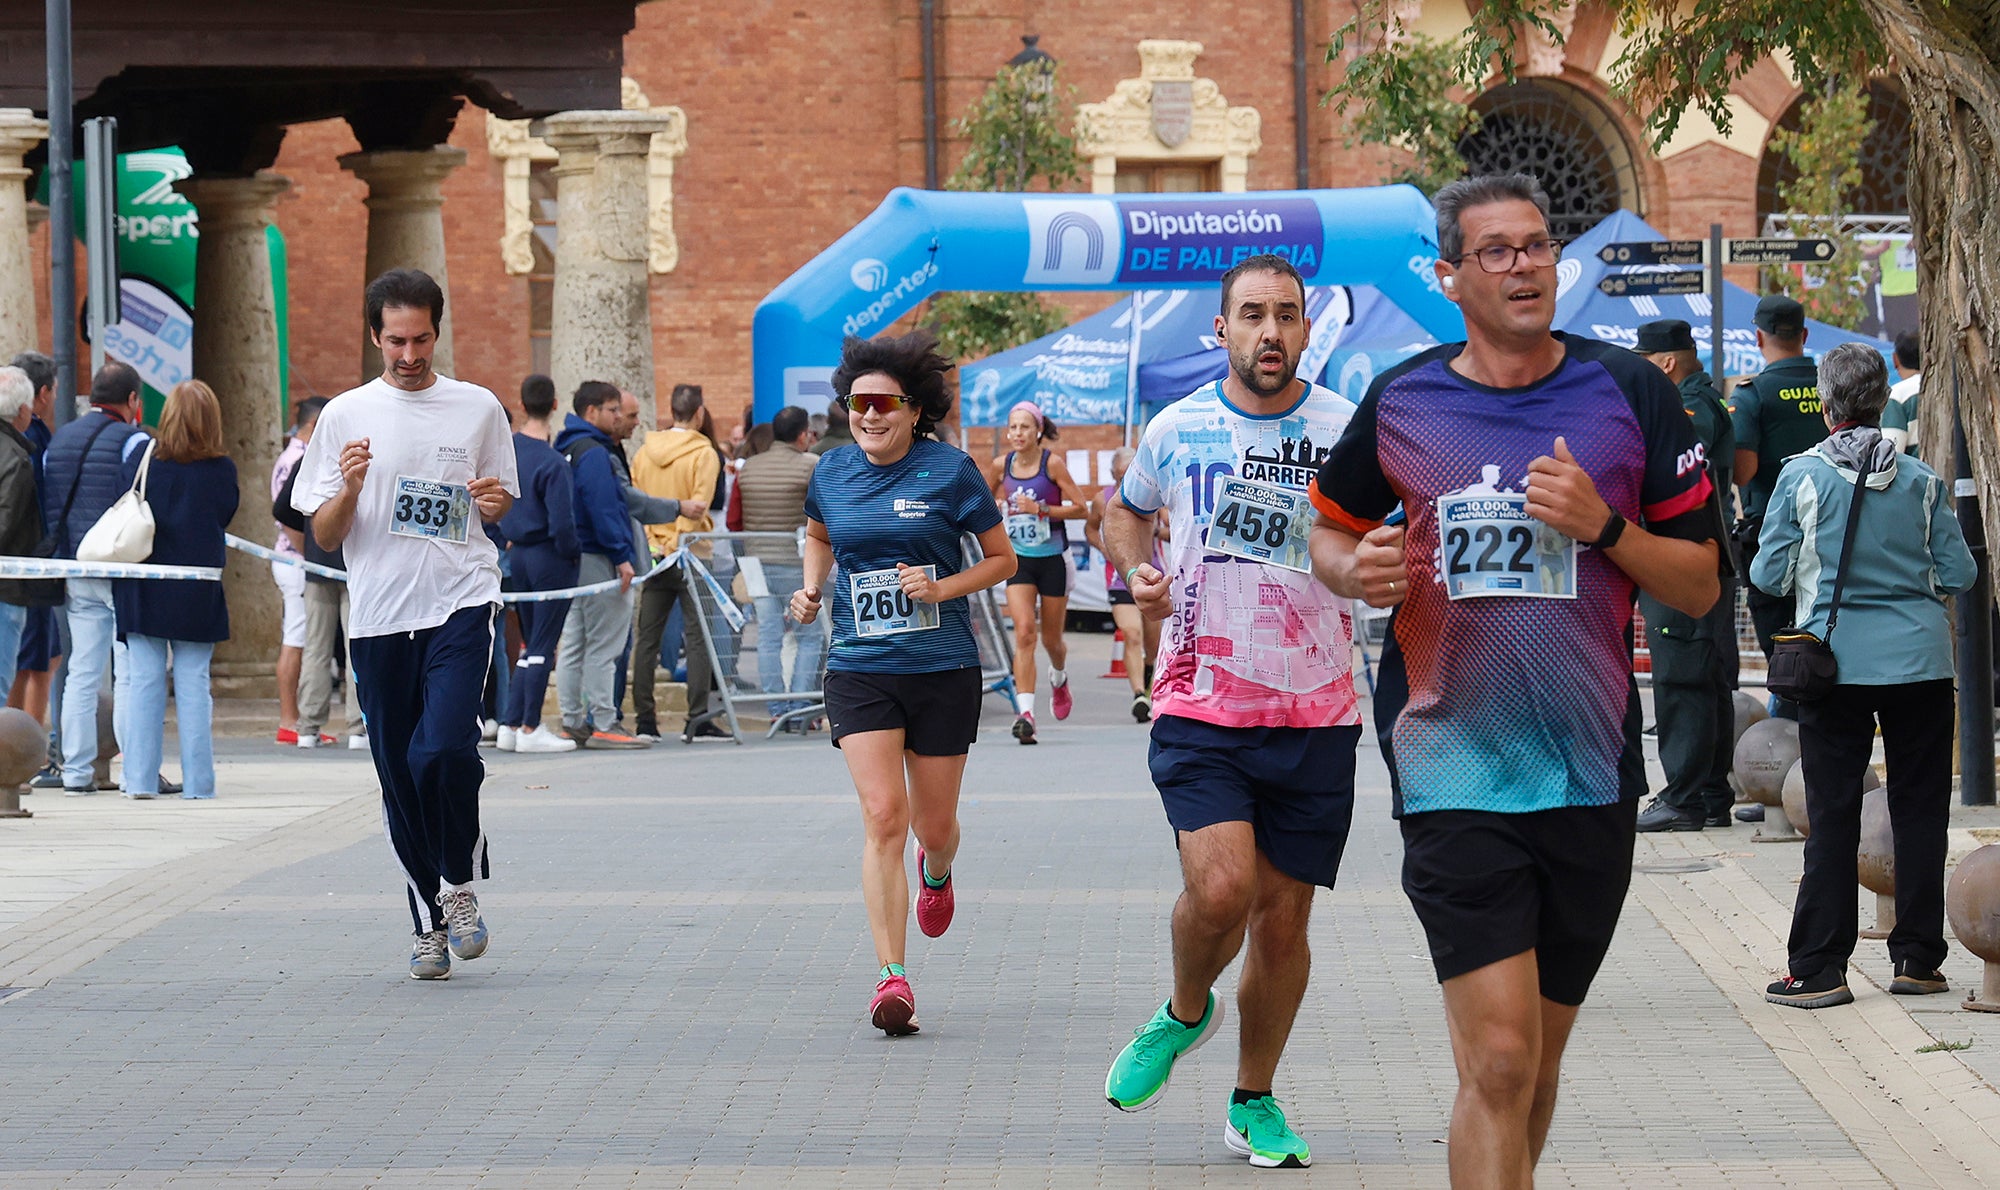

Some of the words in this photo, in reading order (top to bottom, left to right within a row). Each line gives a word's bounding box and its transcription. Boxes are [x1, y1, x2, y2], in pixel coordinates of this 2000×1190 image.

[1129, 209, 1283, 240] Diputación
[1130, 247, 1171, 271] DE
[1733, 239, 1764, 253] Iglesia
[1733, 252, 1760, 262] Santa
[1627, 274, 1653, 286] Canal
[1654, 274, 1665, 285] de
[1666, 272, 1700, 284] Castilla
[842, 260, 938, 337] deportes
[1244, 486, 1277, 500] 10.000
[1466, 501, 1509, 512] 10.000
[395, 494, 451, 529] 333
[1216, 501, 1289, 548] 458
[1009, 524, 1037, 539] 213
[1447, 524, 1534, 575] 222
[857, 588, 914, 622] 260
[1171, 581, 1199, 695] PALENCIA
